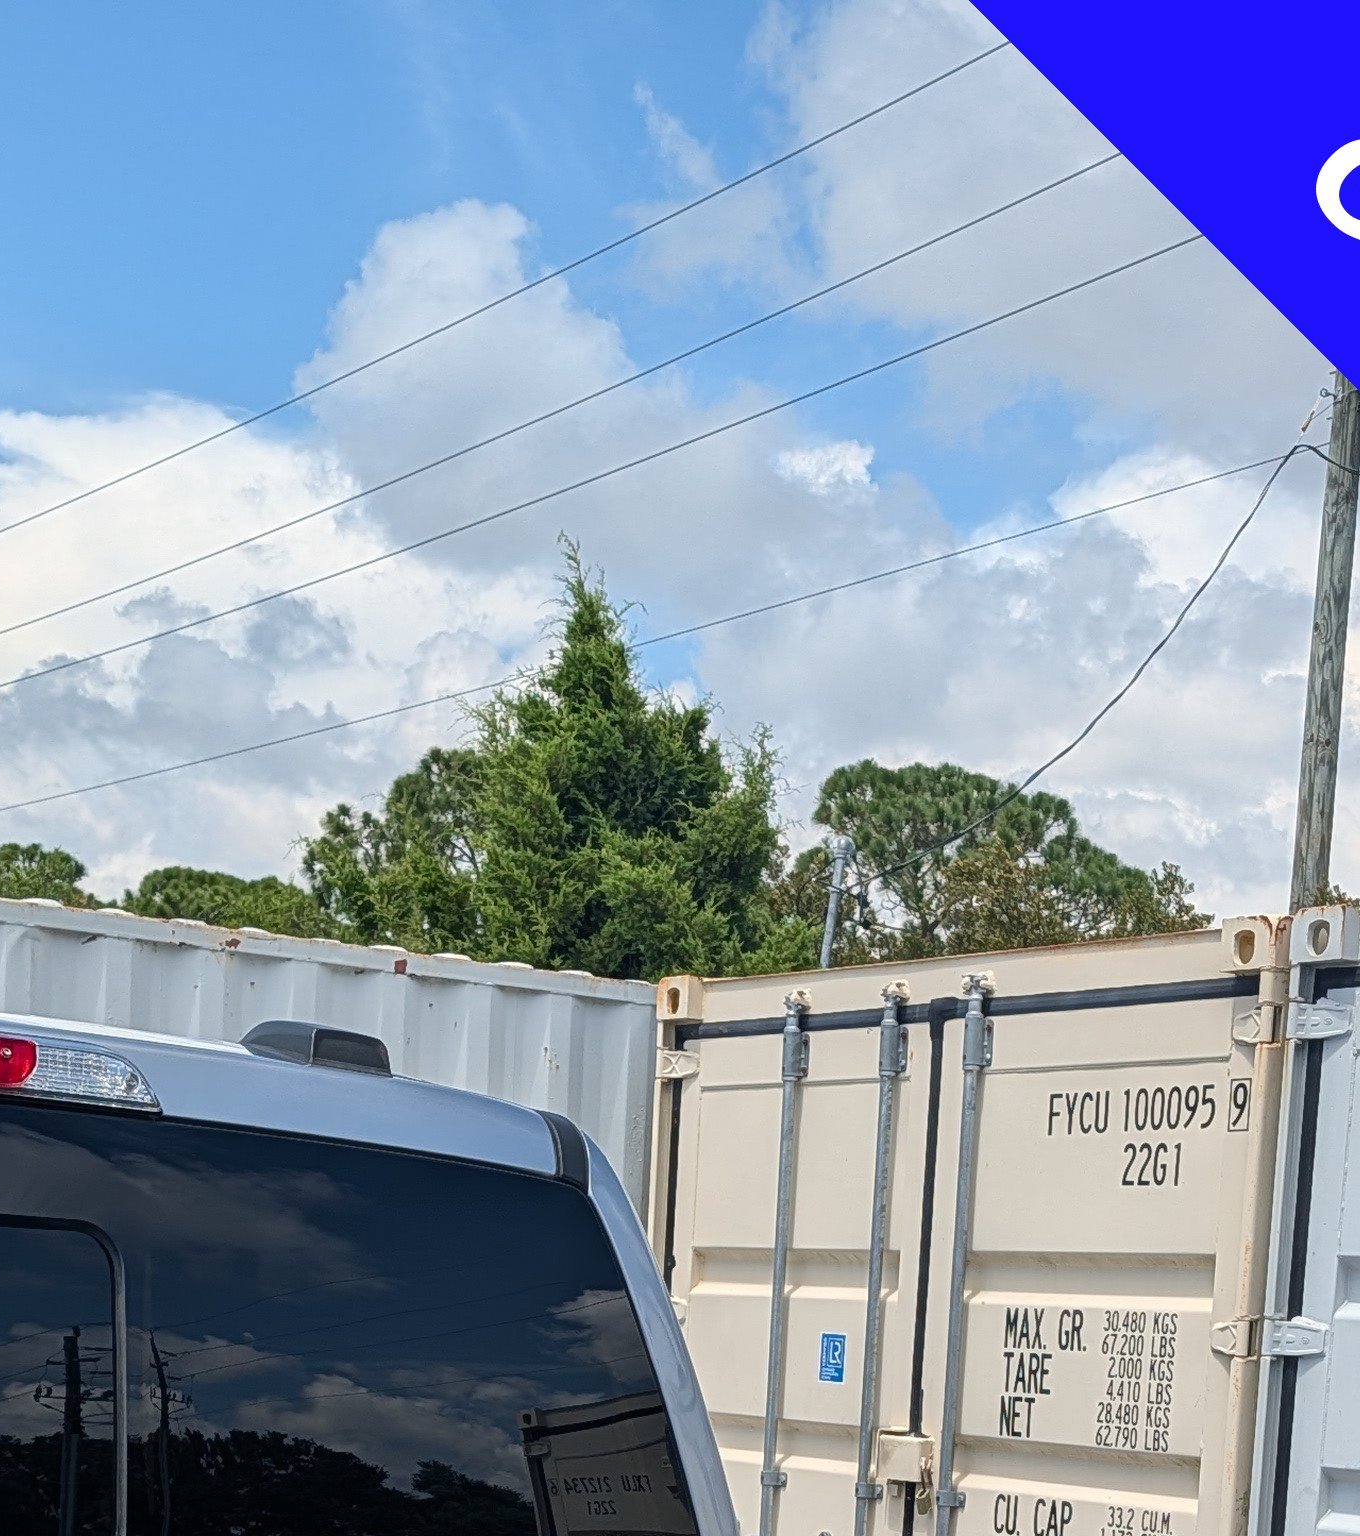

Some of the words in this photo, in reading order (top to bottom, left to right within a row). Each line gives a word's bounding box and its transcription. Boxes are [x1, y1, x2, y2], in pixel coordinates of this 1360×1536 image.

[1048, 1091, 1110, 1135] FYCU
[1123, 1084, 1216, 1132] 100095
[1231, 1081, 1250, 1129] 9
[1121, 1143, 1181, 1186] 22G1
[1004, 1307, 1047, 1349] MAX.
[1058, 1309, 1087, 1352] GR.
[1152, 1312, 1178, 1335] KGS
[1151, 1336, 1176, 1359] LBS
[1003, 1352, 1053, 1395] TARE
[1149, 1359, 1174, 1382] KGS
[1147, 1382, 1172, 1405] LBS
[999, 1395, 1036, 1438] NET
[1145, 1406, 1171, 1429] KGS
[1144, 1429, 1169, 1452] LBS
[993, 1493, 1020, 1536] CU.
[1107, 1506, 1135, 1531] 33.2
